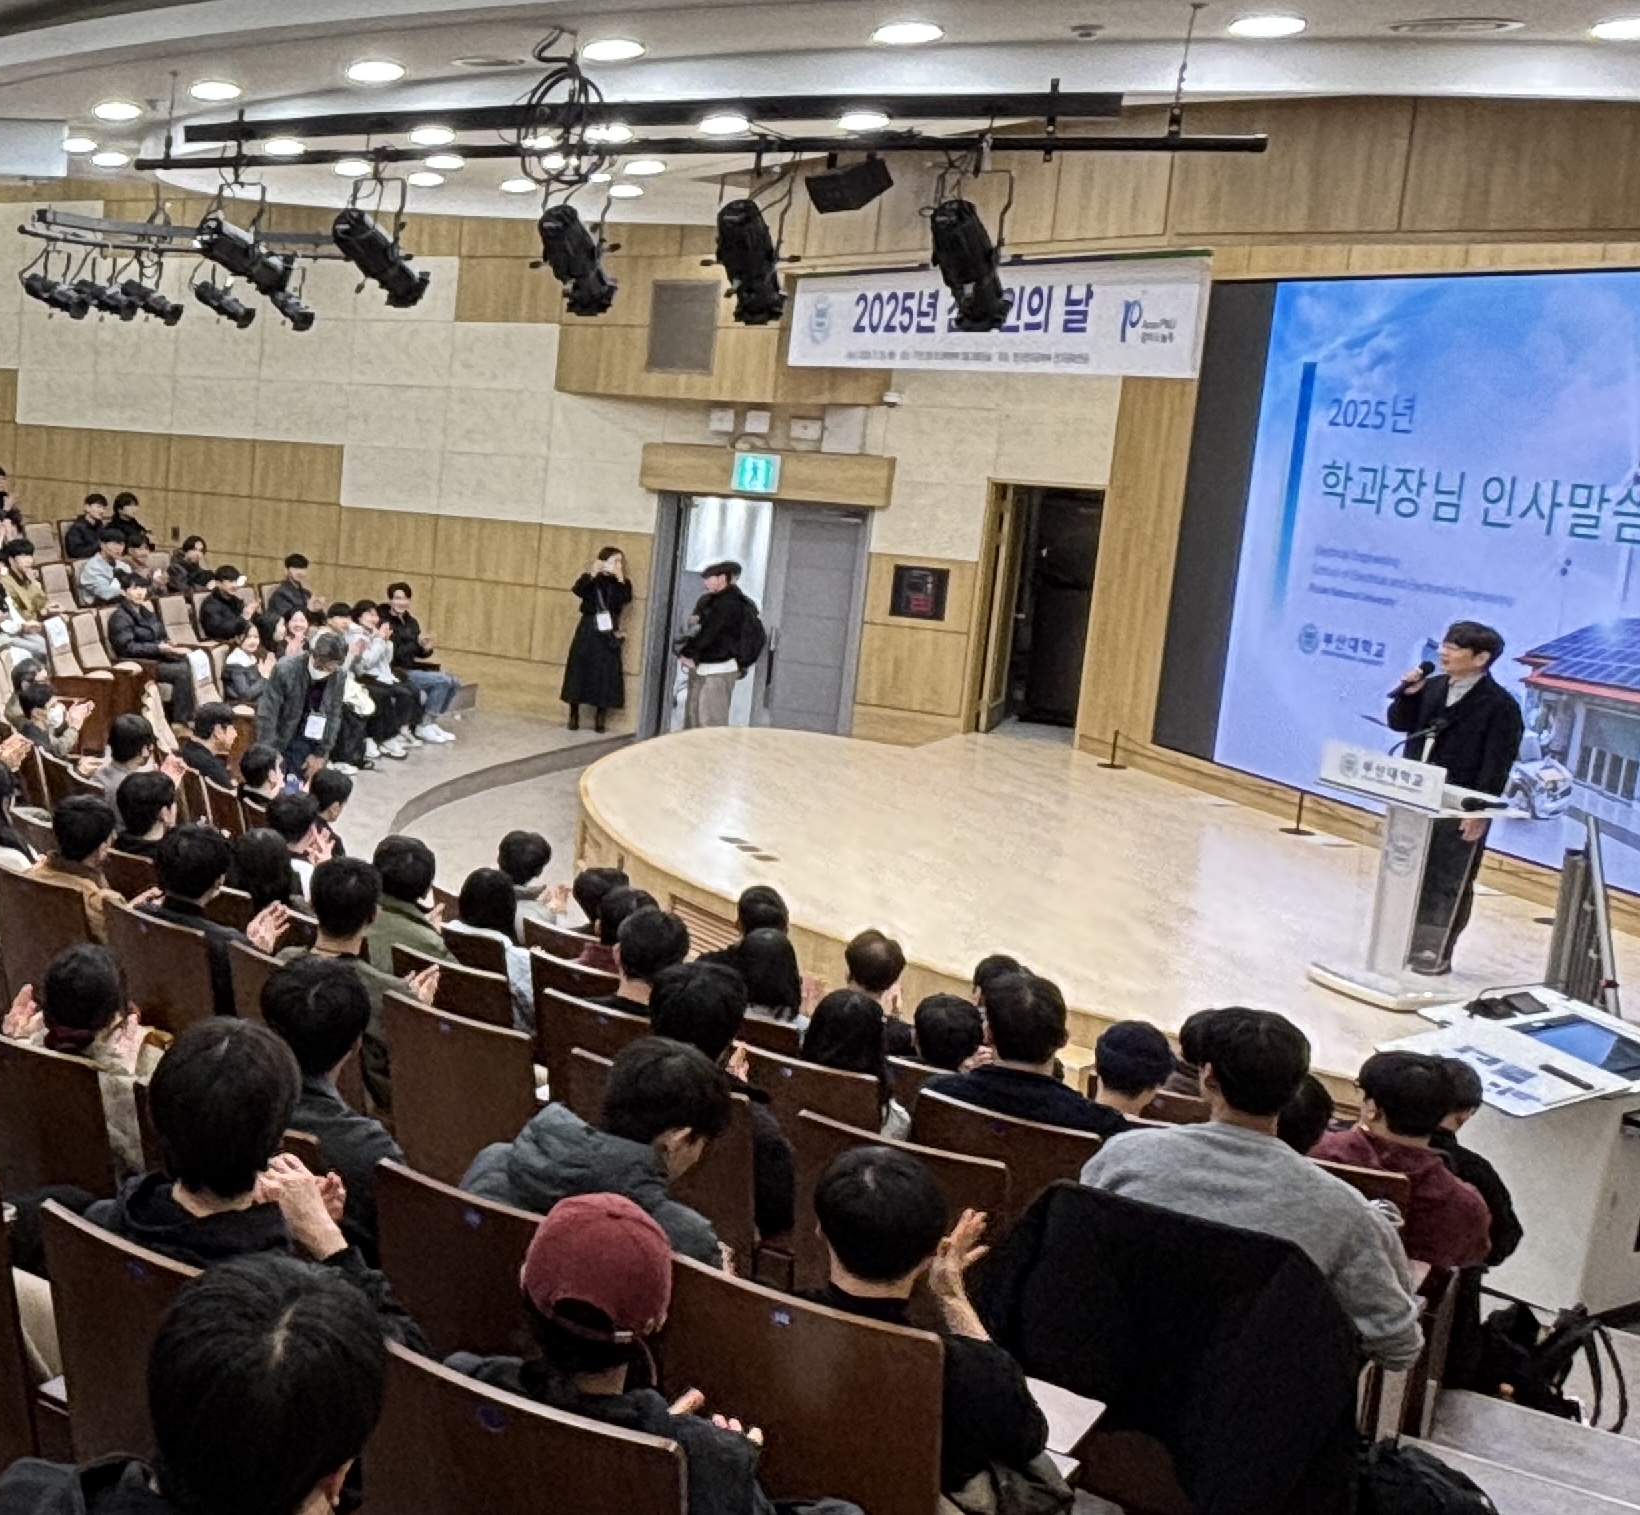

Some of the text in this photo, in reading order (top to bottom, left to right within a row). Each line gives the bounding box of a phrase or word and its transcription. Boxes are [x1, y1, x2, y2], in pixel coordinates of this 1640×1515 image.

[852, 289, 940, 333] 2025년
[1062, 284, 1094, 333] 날
[1328, 392, 1416, 434] 2025년
[1322, 460, 1466, 523] 학과장님
